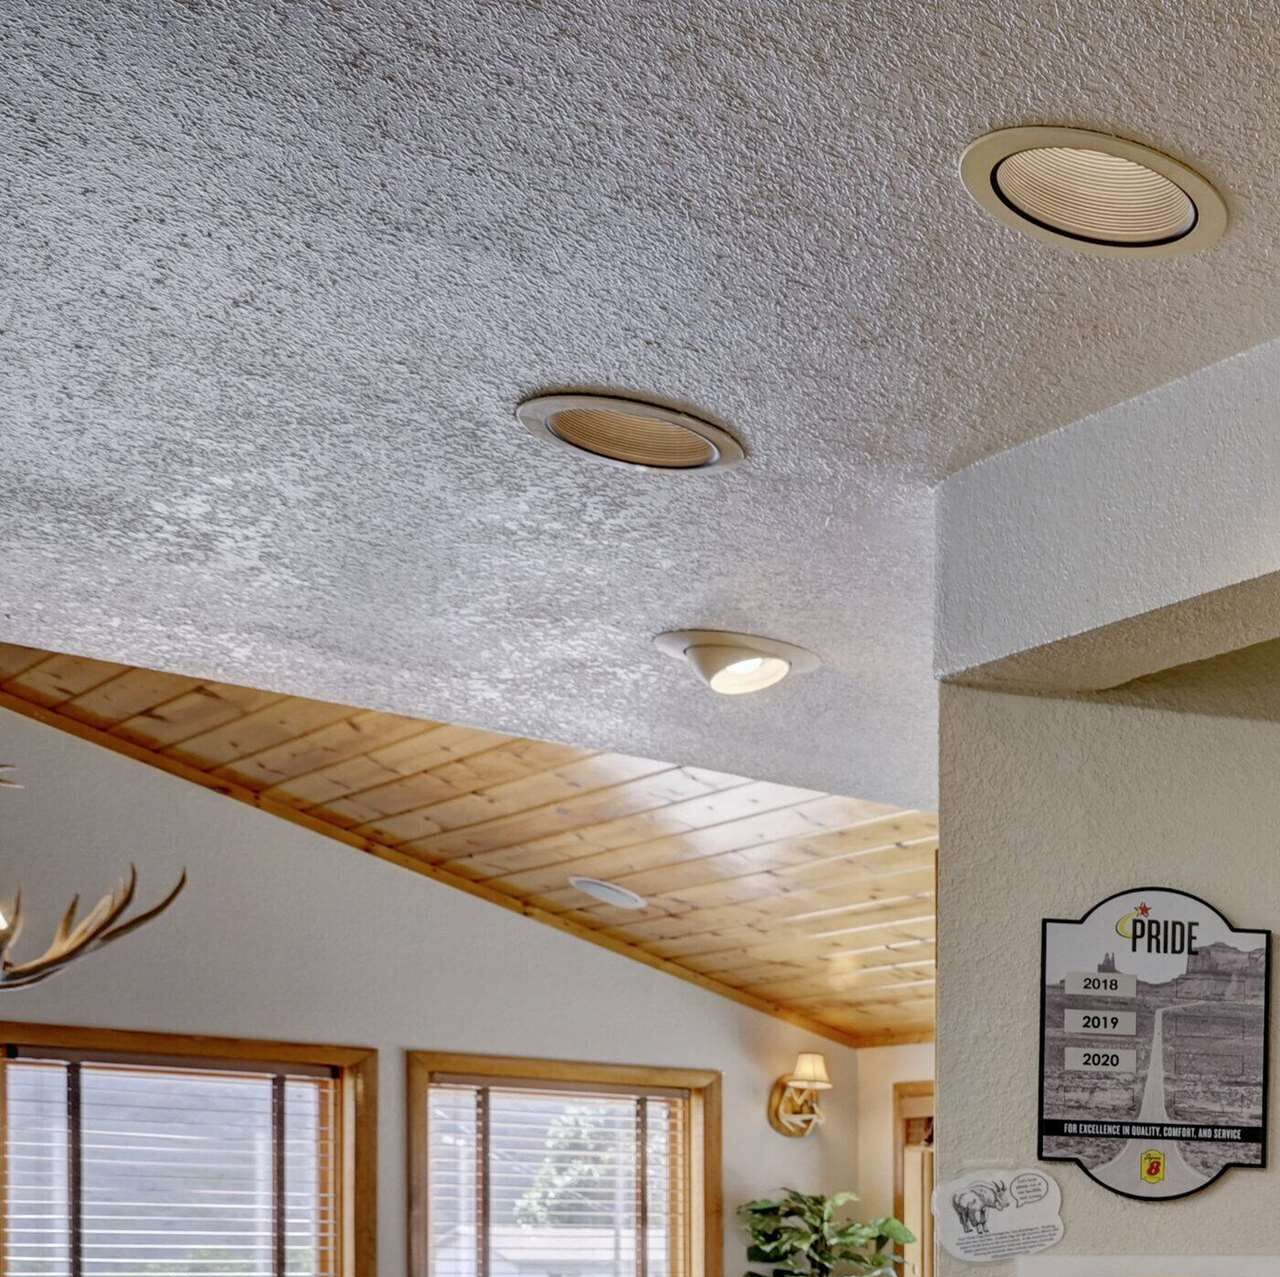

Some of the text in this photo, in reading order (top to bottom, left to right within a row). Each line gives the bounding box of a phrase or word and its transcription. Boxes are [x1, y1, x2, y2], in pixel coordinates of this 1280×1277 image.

[1131, 918, 1199, 956] PRIDE
[1082, 977, 1119, 991] 2018
[1082, 1016, 1119, 1029] 2019
[1082, 1053, 1120, 1067] 2020
[1063, 1123, 1078, 1134] FOR
[1079, 1124, 1120, 1135] EXCELLENCE
[1122, 1126, 1131, 1136] IN
[1198, 1128, 1212, 1138] AND
[1213, 1129, 1241, 1140] SERVICE
[1146, 1160, 1161, 1176] 8
